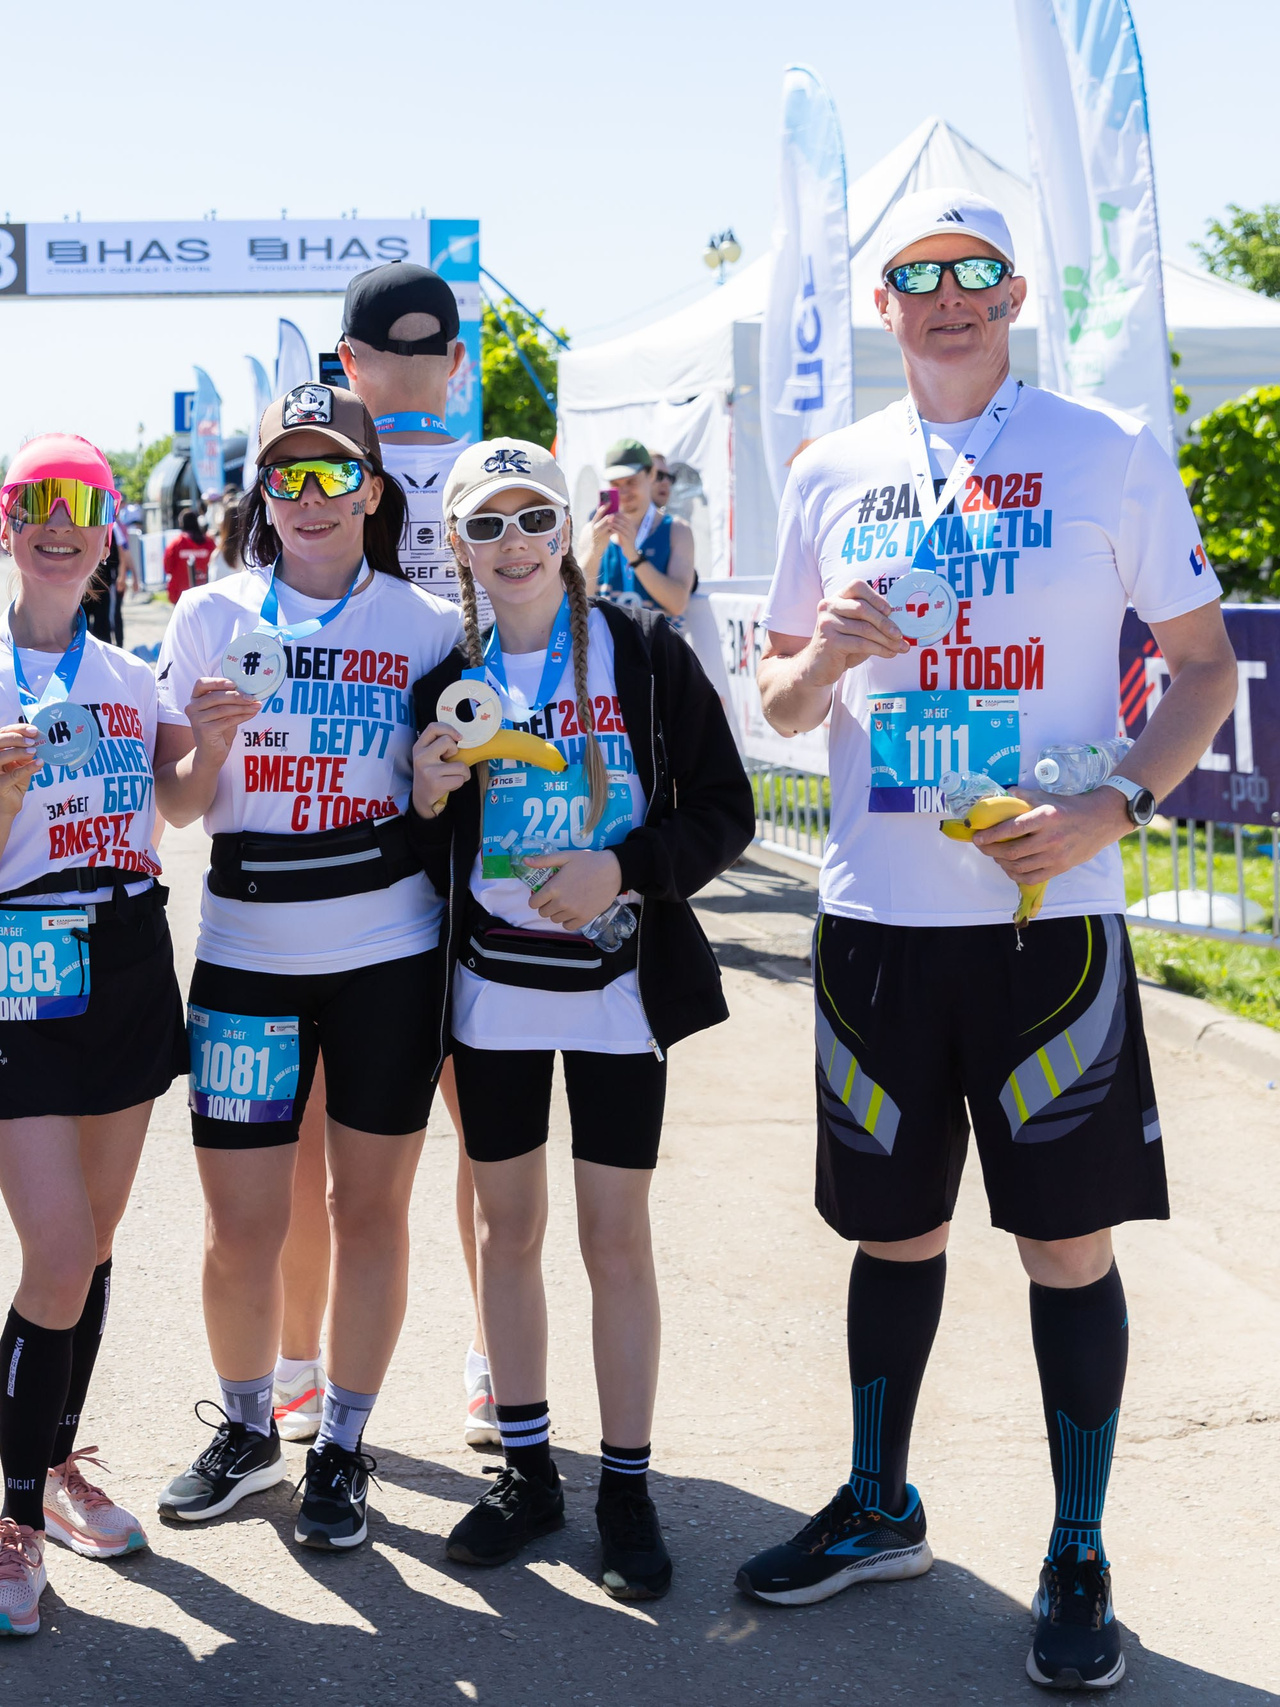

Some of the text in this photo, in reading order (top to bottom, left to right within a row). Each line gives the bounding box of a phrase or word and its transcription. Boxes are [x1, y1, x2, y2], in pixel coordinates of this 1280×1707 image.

[98, 239, 210, 263] HAS
[841, 520, 898, 565] 45%
[405, 567, 439, 578] БЕГ
[555, 631, 567, 650] ПСБ
[920, 636, 1045, 691] С ТОБОЙ
[310, 718, 395, 759] БЕГУТ
[906, 724, 969, 781] 1111
[244, 755, 348, 793] ВМЕСТЕ
[499, 777, 514, 785] ПСБ
[291, 795, 312, 832] С
[912, 786, 947, 813] 10К
[48, 812, 135, 861] ВМЕСТЕ
[523, 795, 594, 848] 220
[201, 1040, 270, 1095] 1081
[8, 1477, 36, 1491] RIGHT
